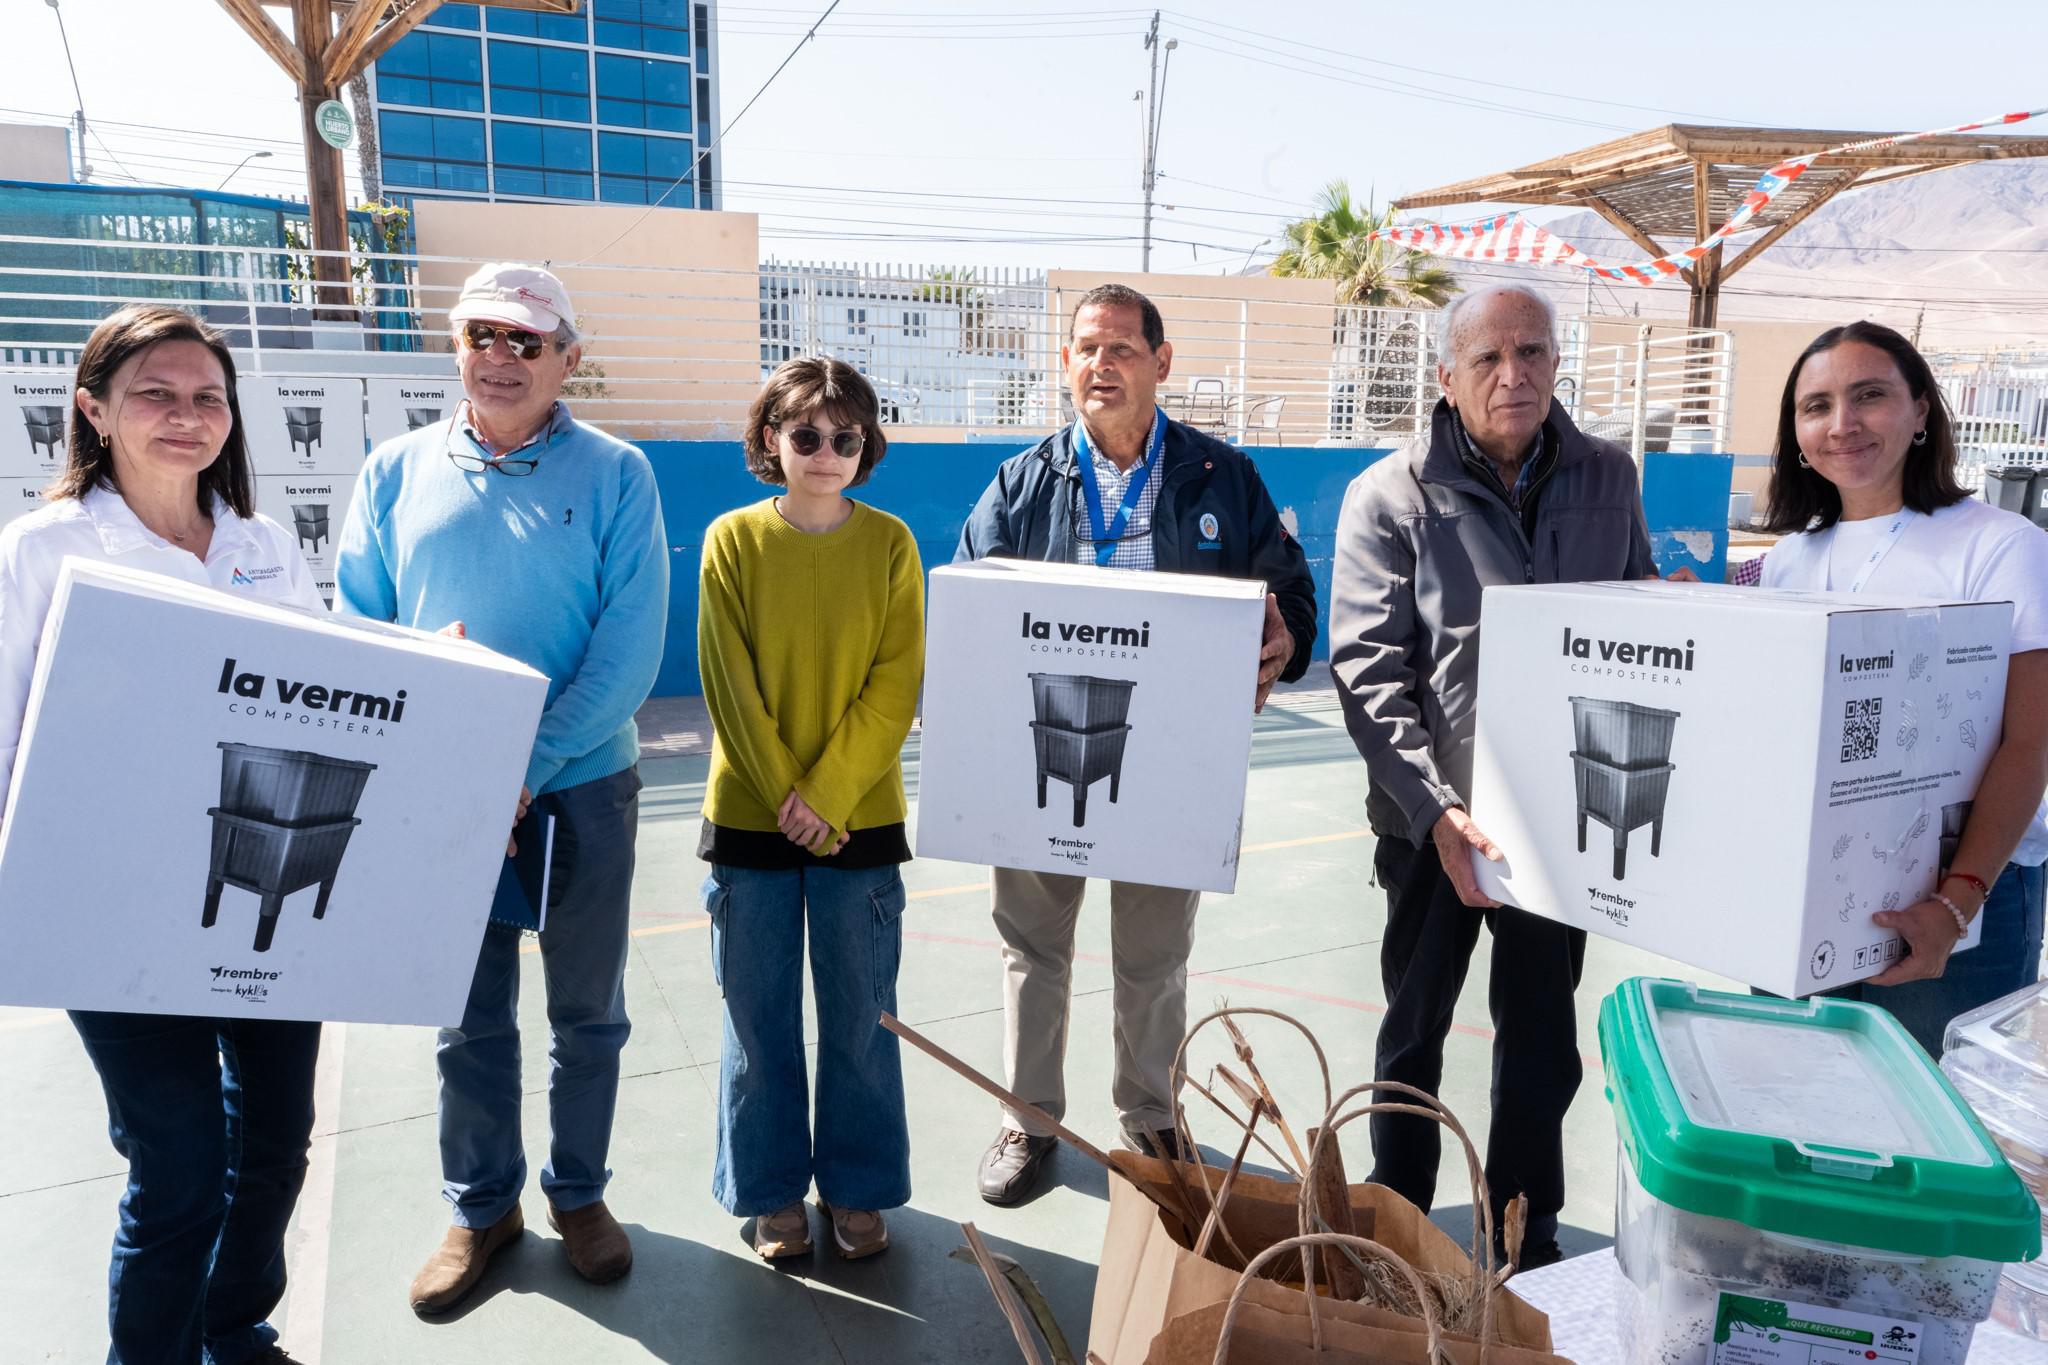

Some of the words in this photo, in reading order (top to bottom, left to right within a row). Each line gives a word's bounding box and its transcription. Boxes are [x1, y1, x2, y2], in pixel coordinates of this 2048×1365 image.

[325, 119, 350, 130] HUERTO
[325, 125, 350, 136] URBANO
[14, 385, 27, 395] la
[29, 385, 67, 395] vermi
[278, 387, 289, 397] la
[291, 388, 325, 397] vermi
[401, 389, 412, 399] la
[413, 390, 445, 399] vermi
[23, 488, 35, 498] la
[285, 485, 297, 495] la
[299, 485, 332, 494] vermi
[1022, 612, 1051, 640] la
[1058, 621, 1150, 648] vermi
[1031, 644, 1138, 660] COMPOSTERA
[1563, 627, 1591, 659] la
[1598, 639, 1695, 671] vermi
[1840, 653, 1854, 673] la
[1855, 649, 1894, 672] vermi
[1571, 663, 1682, 686] COMPOSTERA
[1843, 672, 1889, 682] COMPOSTERA
[217, 657, 265, 699] la
[276, 678, 408, 723] vermi
[229, 703, 385, 737] COMPOSTERA
[1849, 777, 1863, 787] parte
[1863, 775, 1869, 783] de
[1869, 774, 1875, 782] la
[1056, 839, 1094, 849] rembre
[1597, 891, 1634, 908] rembre
[222, 967, 279, 981] rembre
[1785, 1319, 1809, 1329] ¿QUÉ
[1810, 1323, 1857, 1337] RECICLAR?
[1848, 1348, 1861, 1356] NO
[1880, 1343, 1914, 1353] HUERTA
